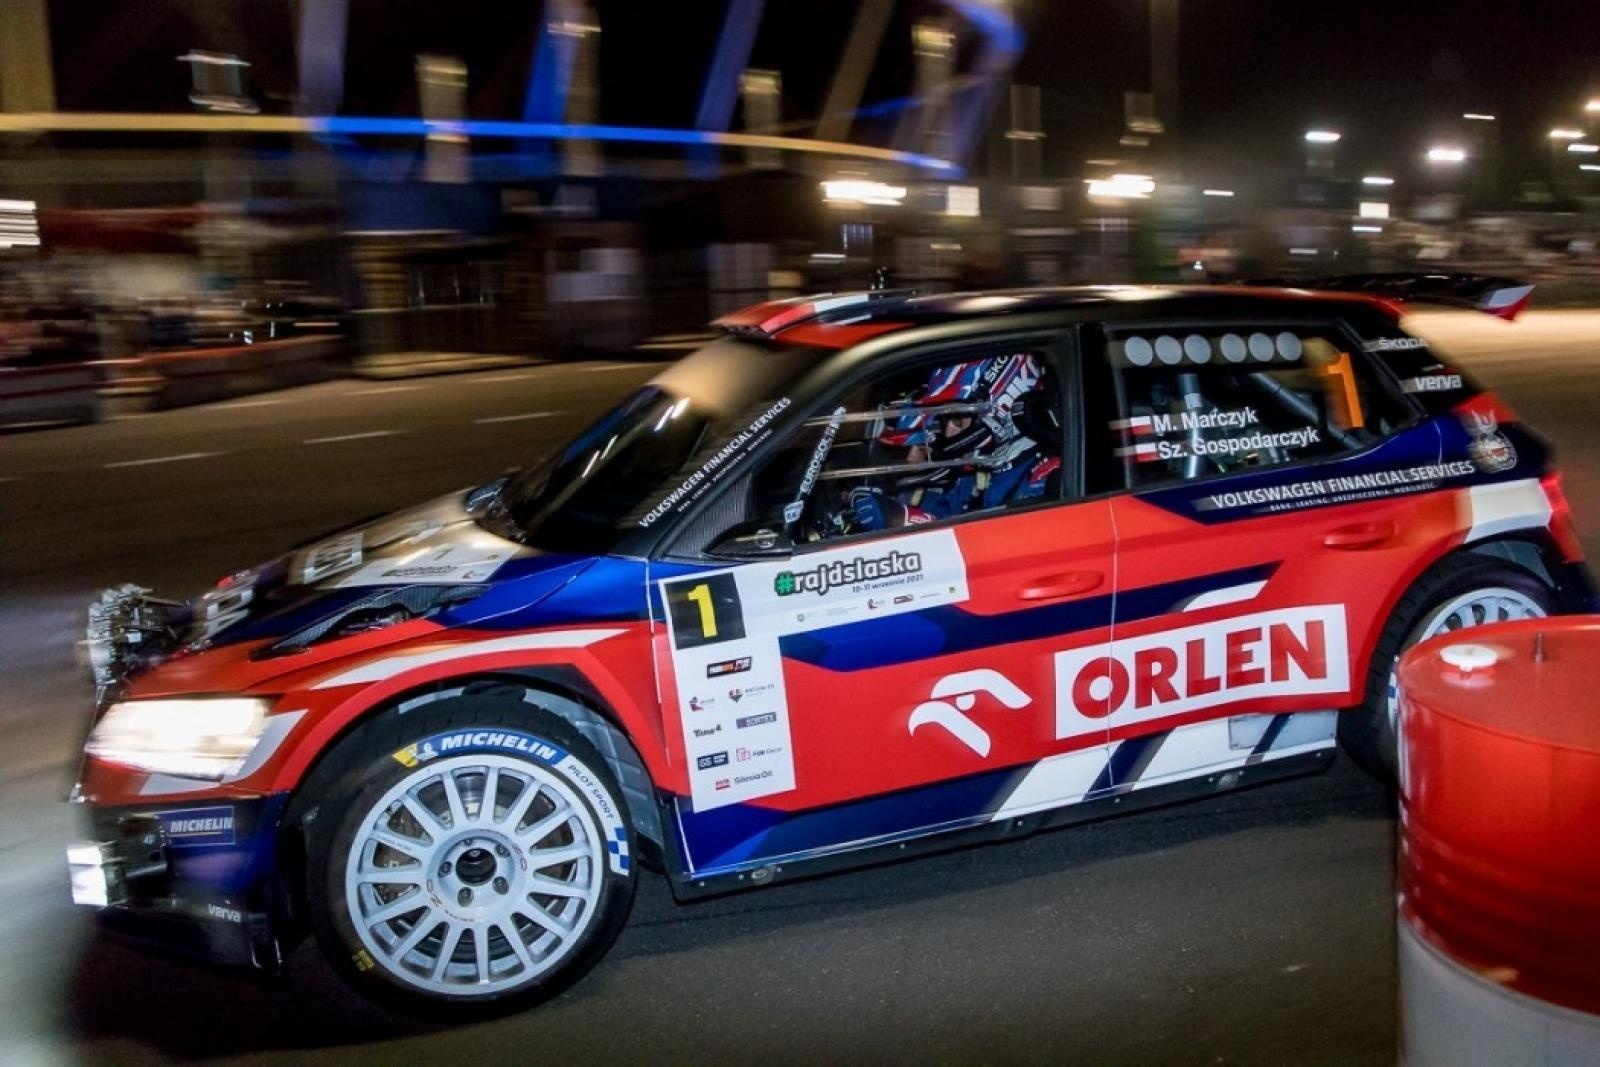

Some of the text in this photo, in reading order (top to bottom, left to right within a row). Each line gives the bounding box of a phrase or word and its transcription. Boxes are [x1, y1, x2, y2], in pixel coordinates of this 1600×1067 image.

[1328, 352, 1364, 428] 1
[1415, 374, 1462, 390] verva
[1152, 406, 1259, 433] M. Marczyk
[638, 470, 705, 528] VOLKSWAGEN
[703, 430, 753, 473] FINANCIAL
[750, 397, 791, 434] SERVICES
[1157, 426, 1321, 460] Sz. Gospodarczyk
[1211, 460, 1475, 509] VOLKSWAGEN FINANCIAL SERVICES
[774, 551, 921, 596] #rajdslaska
[687, 584, 718, 638] 1
[1072, 619, 1328, 719] ORLEN
[441, 732, 558, 760] MICHELIN
[568, 764, 615, 820] PILOT SPORT
[170, 817, 234, 833] MICHELIN
[208, 903, 242, 923] verva
